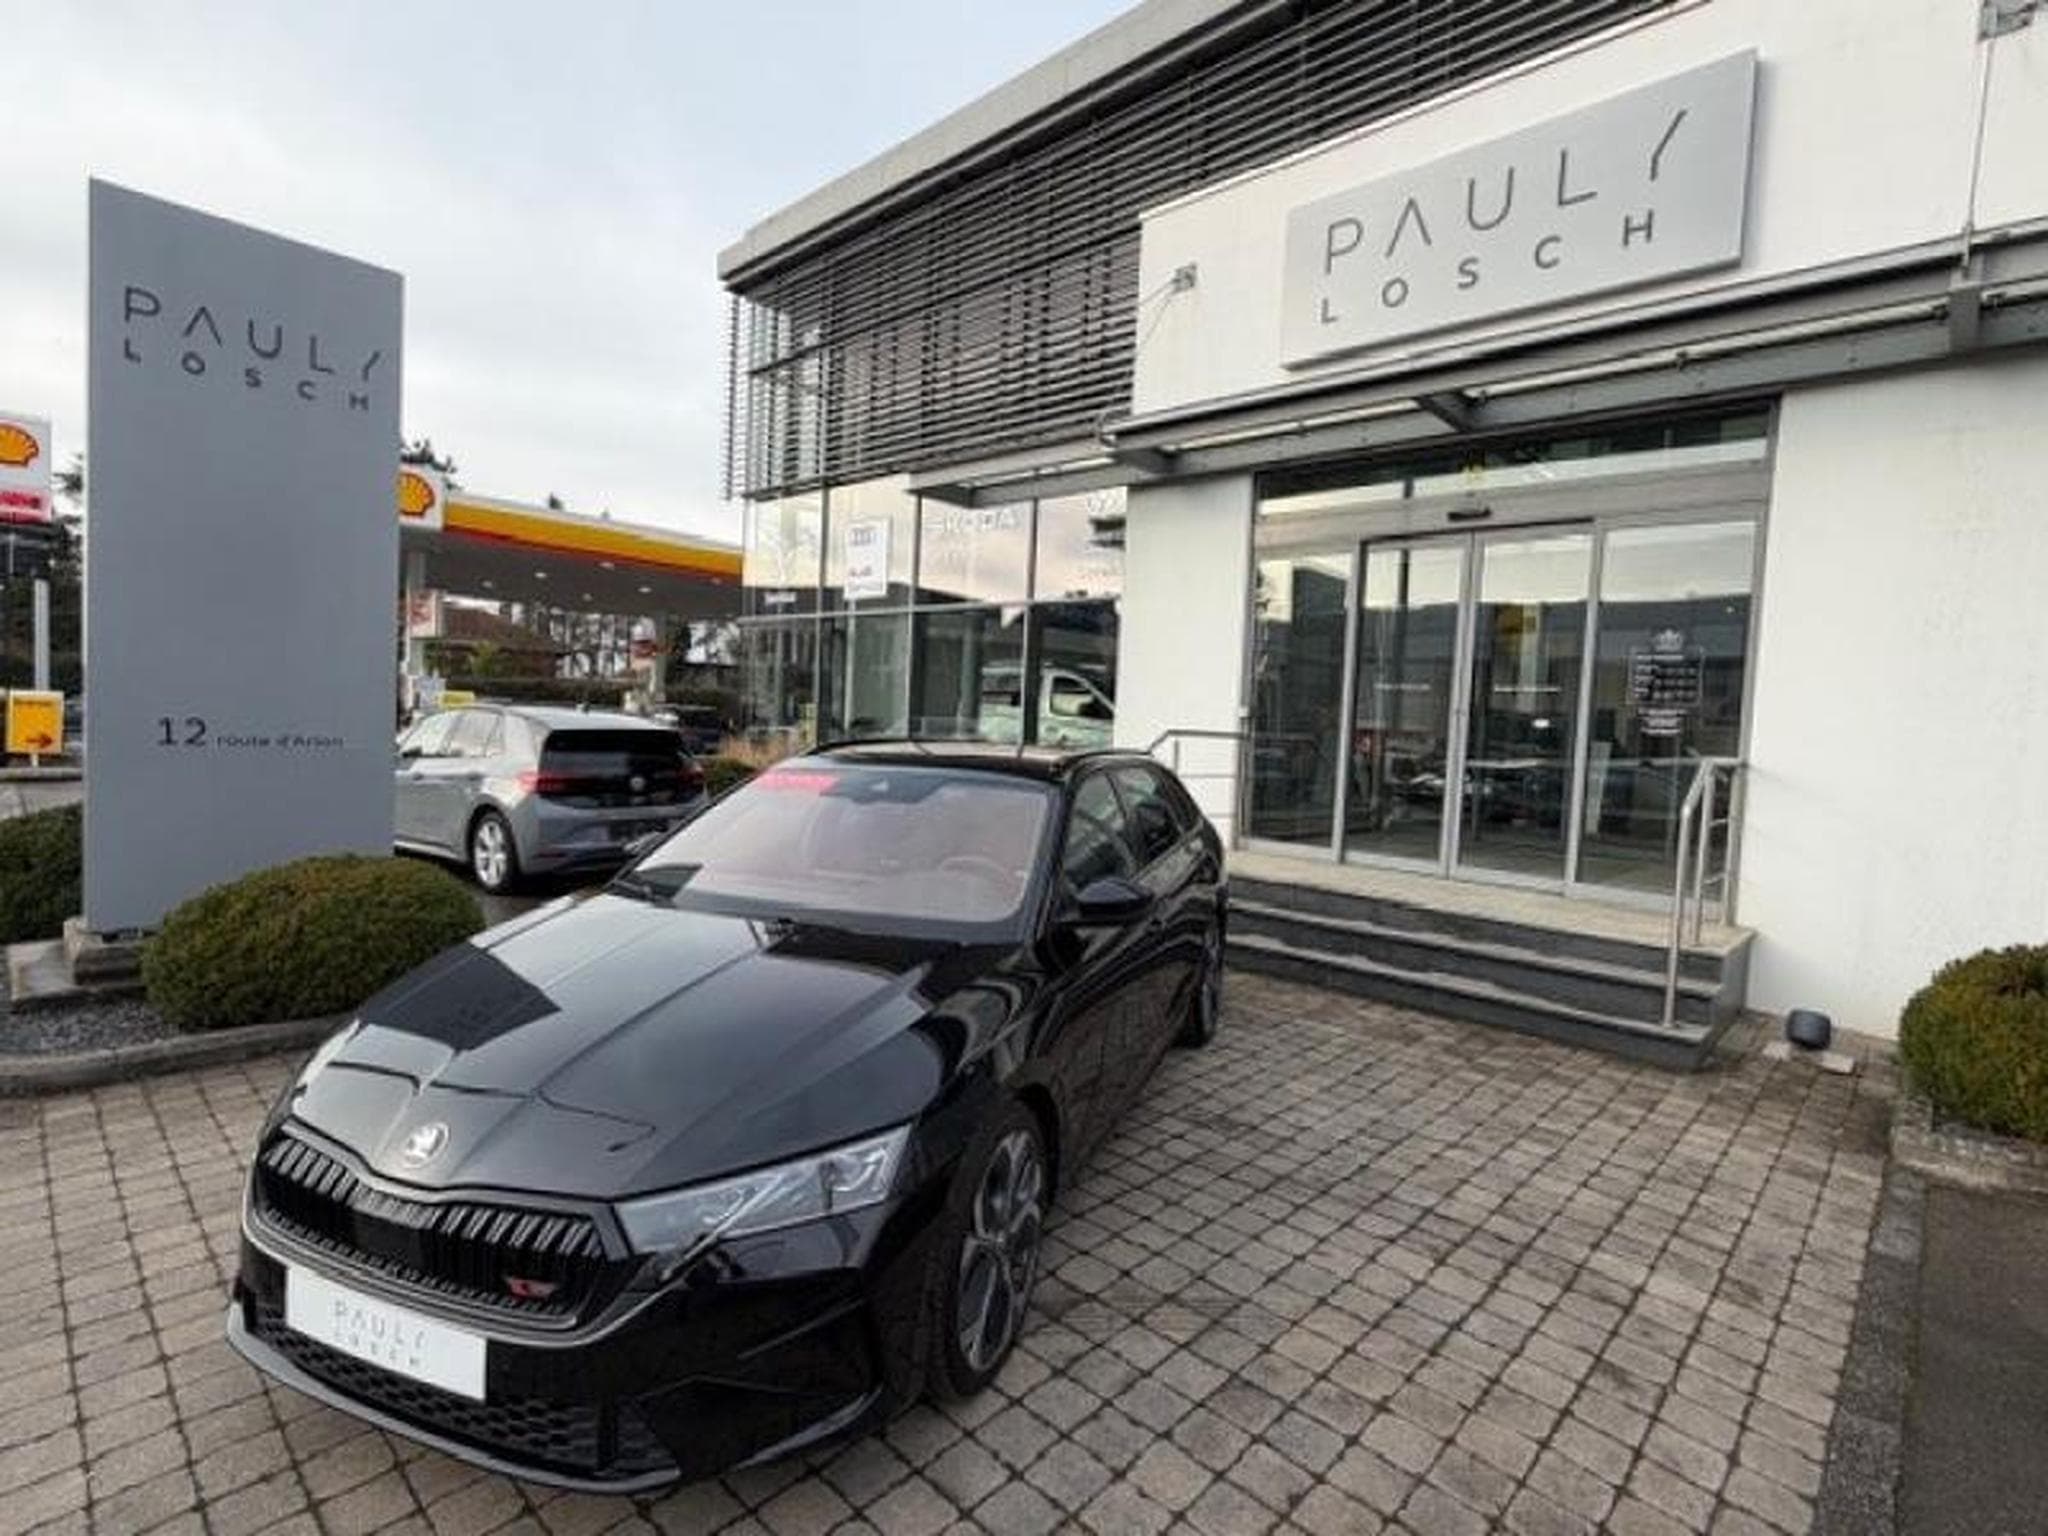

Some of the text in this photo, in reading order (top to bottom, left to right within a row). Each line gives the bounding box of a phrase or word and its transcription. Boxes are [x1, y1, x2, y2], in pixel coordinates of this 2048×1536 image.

[1326, 109, 1687, 274] PAULY
[1321, 209, 1654, 324] LOSCH
[123, 338, 369, 410] LOSCH
[124, 286, 381, 381] PAULY
[157, 716, 207, 747] 12
